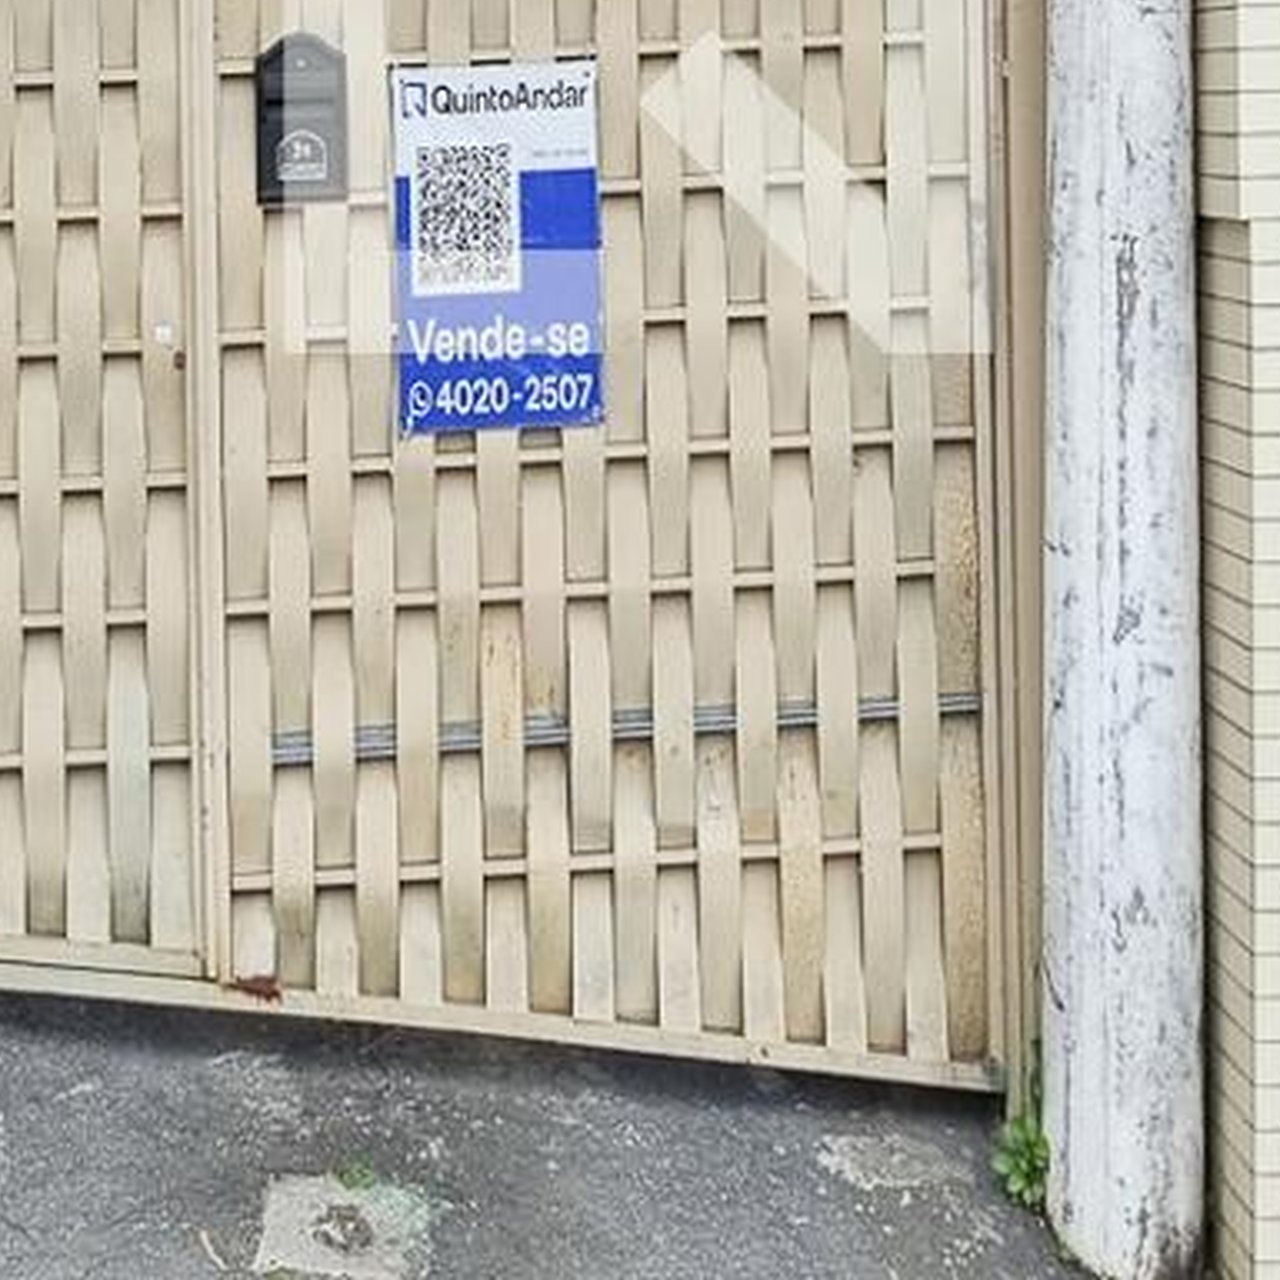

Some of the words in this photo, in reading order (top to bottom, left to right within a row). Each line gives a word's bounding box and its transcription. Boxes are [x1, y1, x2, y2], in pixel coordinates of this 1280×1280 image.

[431, 81, 587, 114] QuintoAndar
[407, 315, 590, 363] Vende-se
[436, 373, 593, 415] 4020-2507
